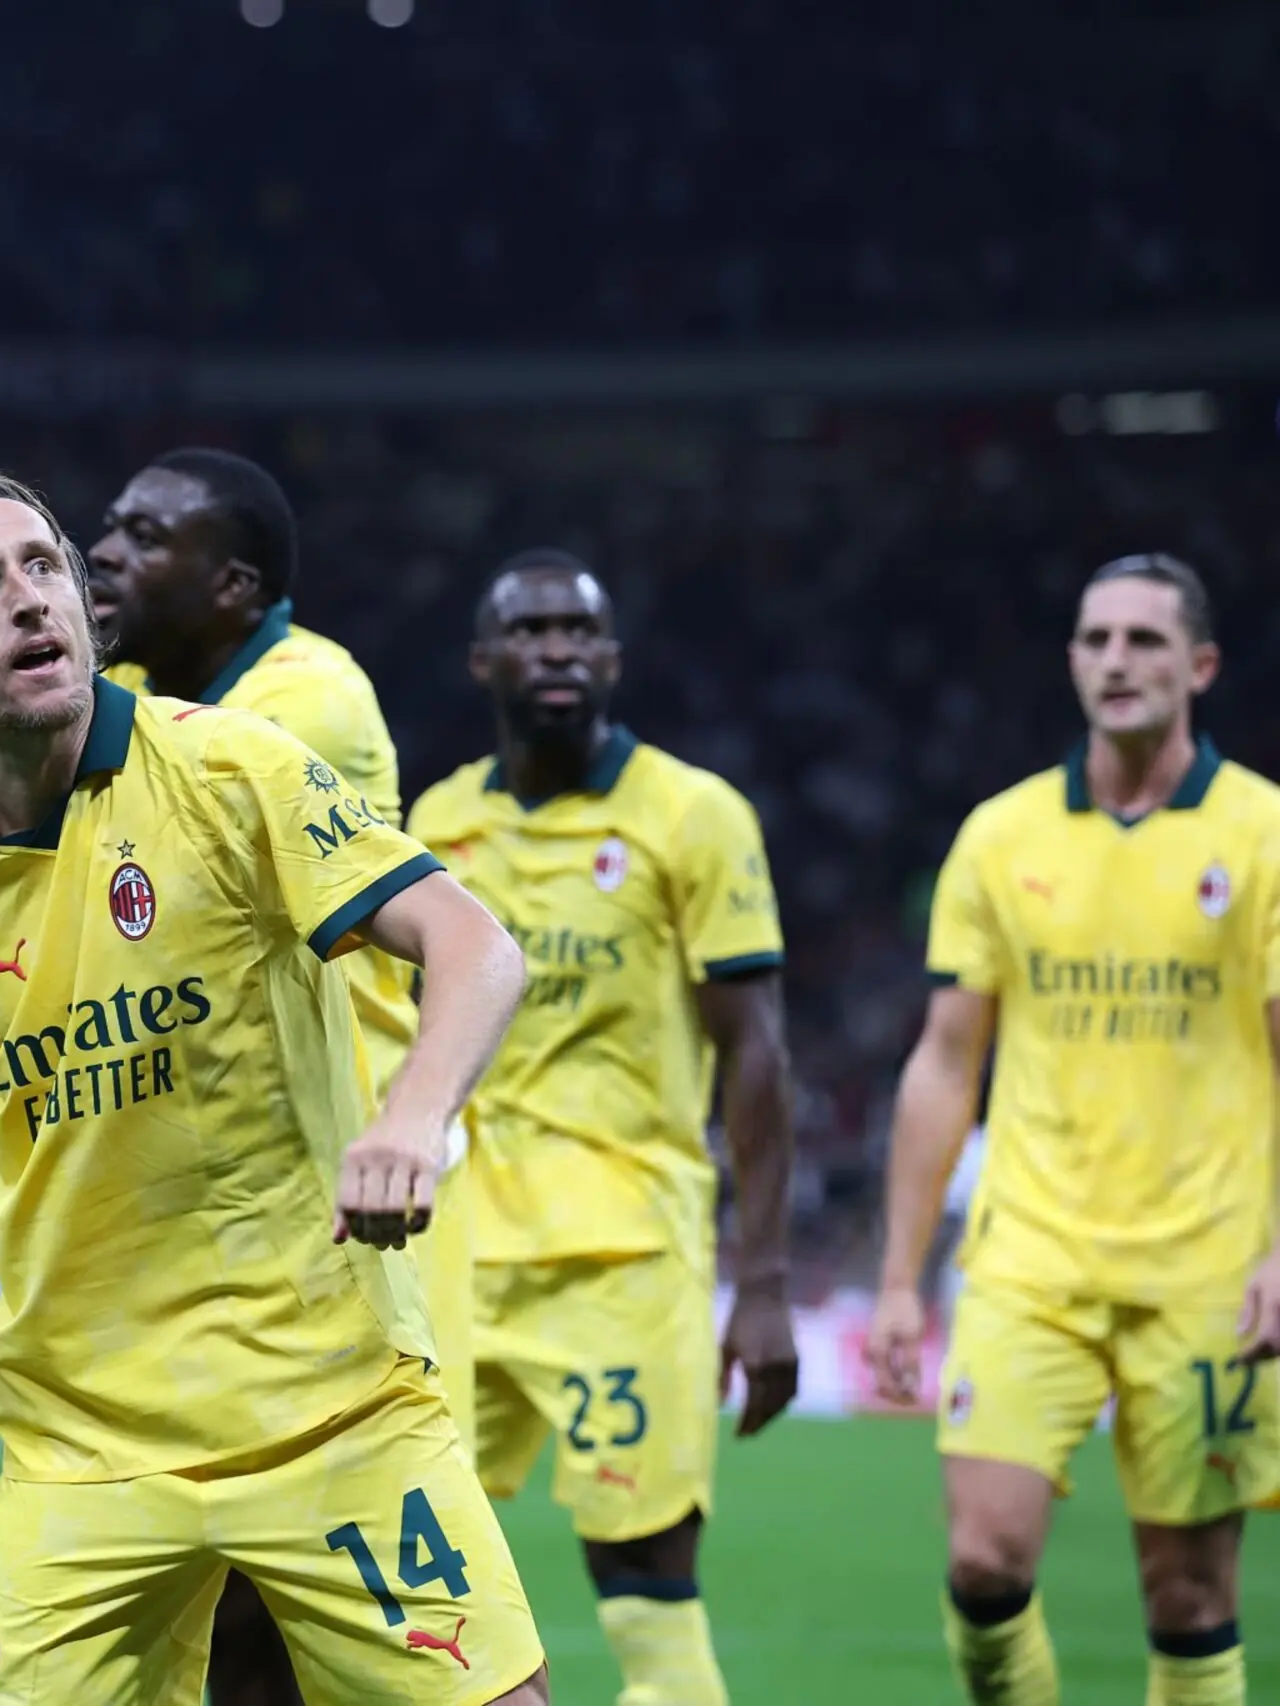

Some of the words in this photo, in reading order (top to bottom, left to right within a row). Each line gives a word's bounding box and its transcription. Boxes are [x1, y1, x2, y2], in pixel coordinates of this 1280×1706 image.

[118, 868, 143, 884] ACM
[125, 921, 146, 932] 1899
[563, 1367, 649, 1452] 23
[1191, 1357, 1257, 1438] 12
[326, 1487, 471, 1627] 14
